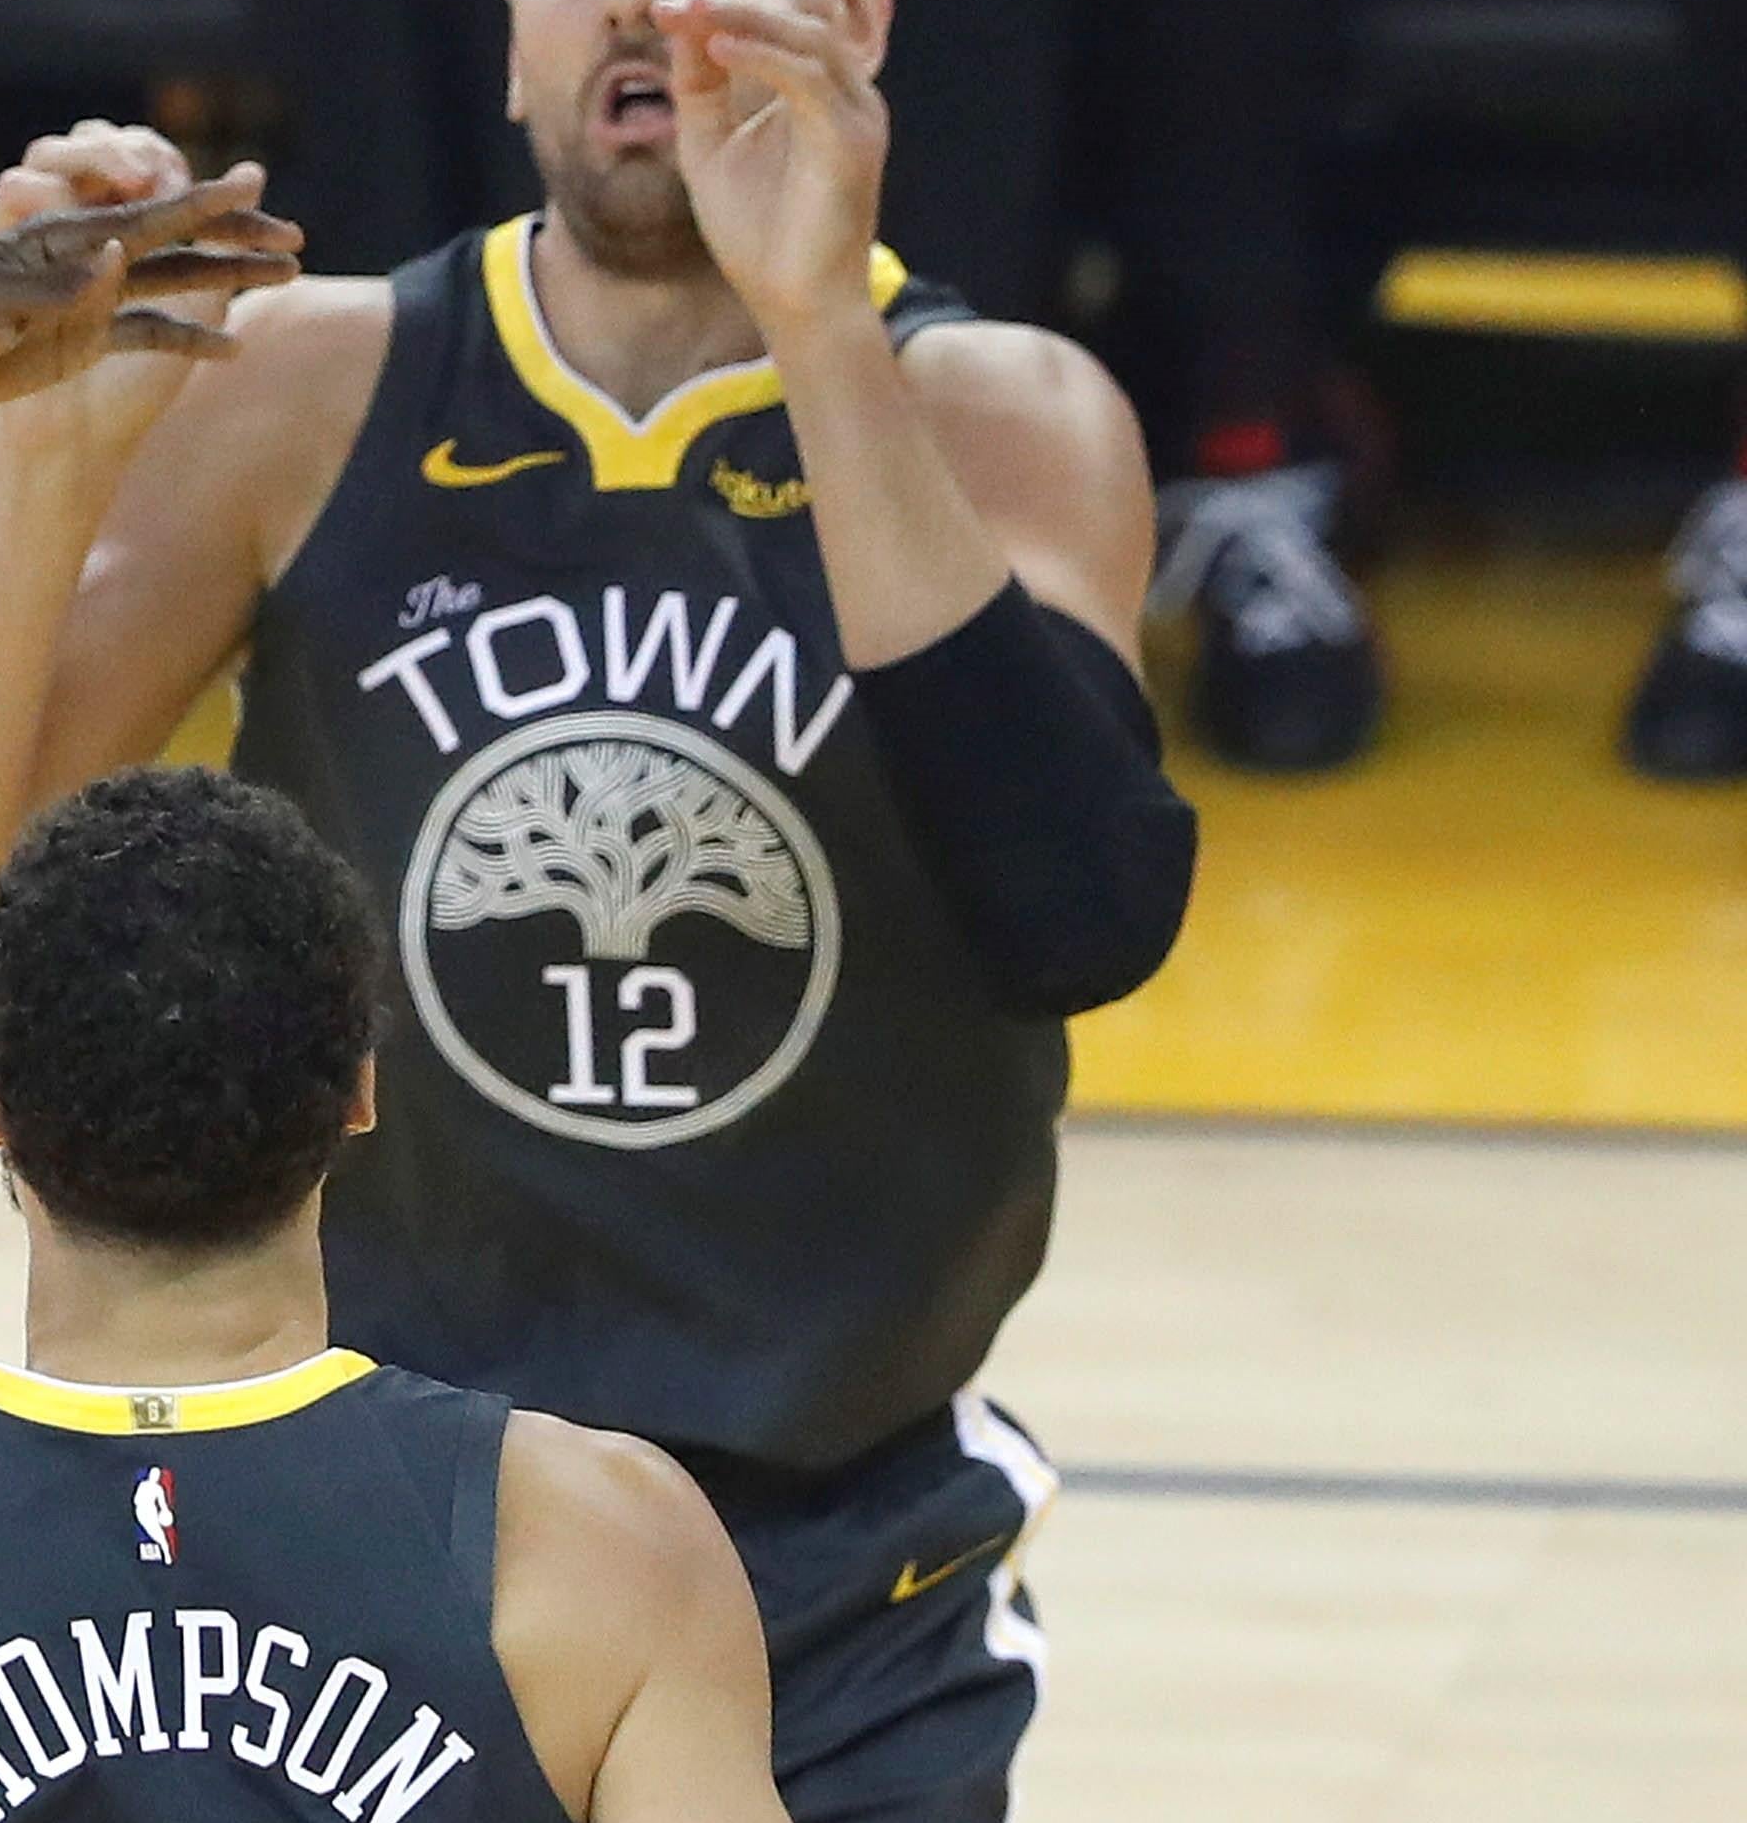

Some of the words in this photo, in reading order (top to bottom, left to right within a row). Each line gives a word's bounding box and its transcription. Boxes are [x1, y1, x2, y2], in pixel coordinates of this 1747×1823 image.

[396, 574, 484, 630] The
[357, 585, 854, 776] TOWN
[541, 962, 701, 1109] 12
